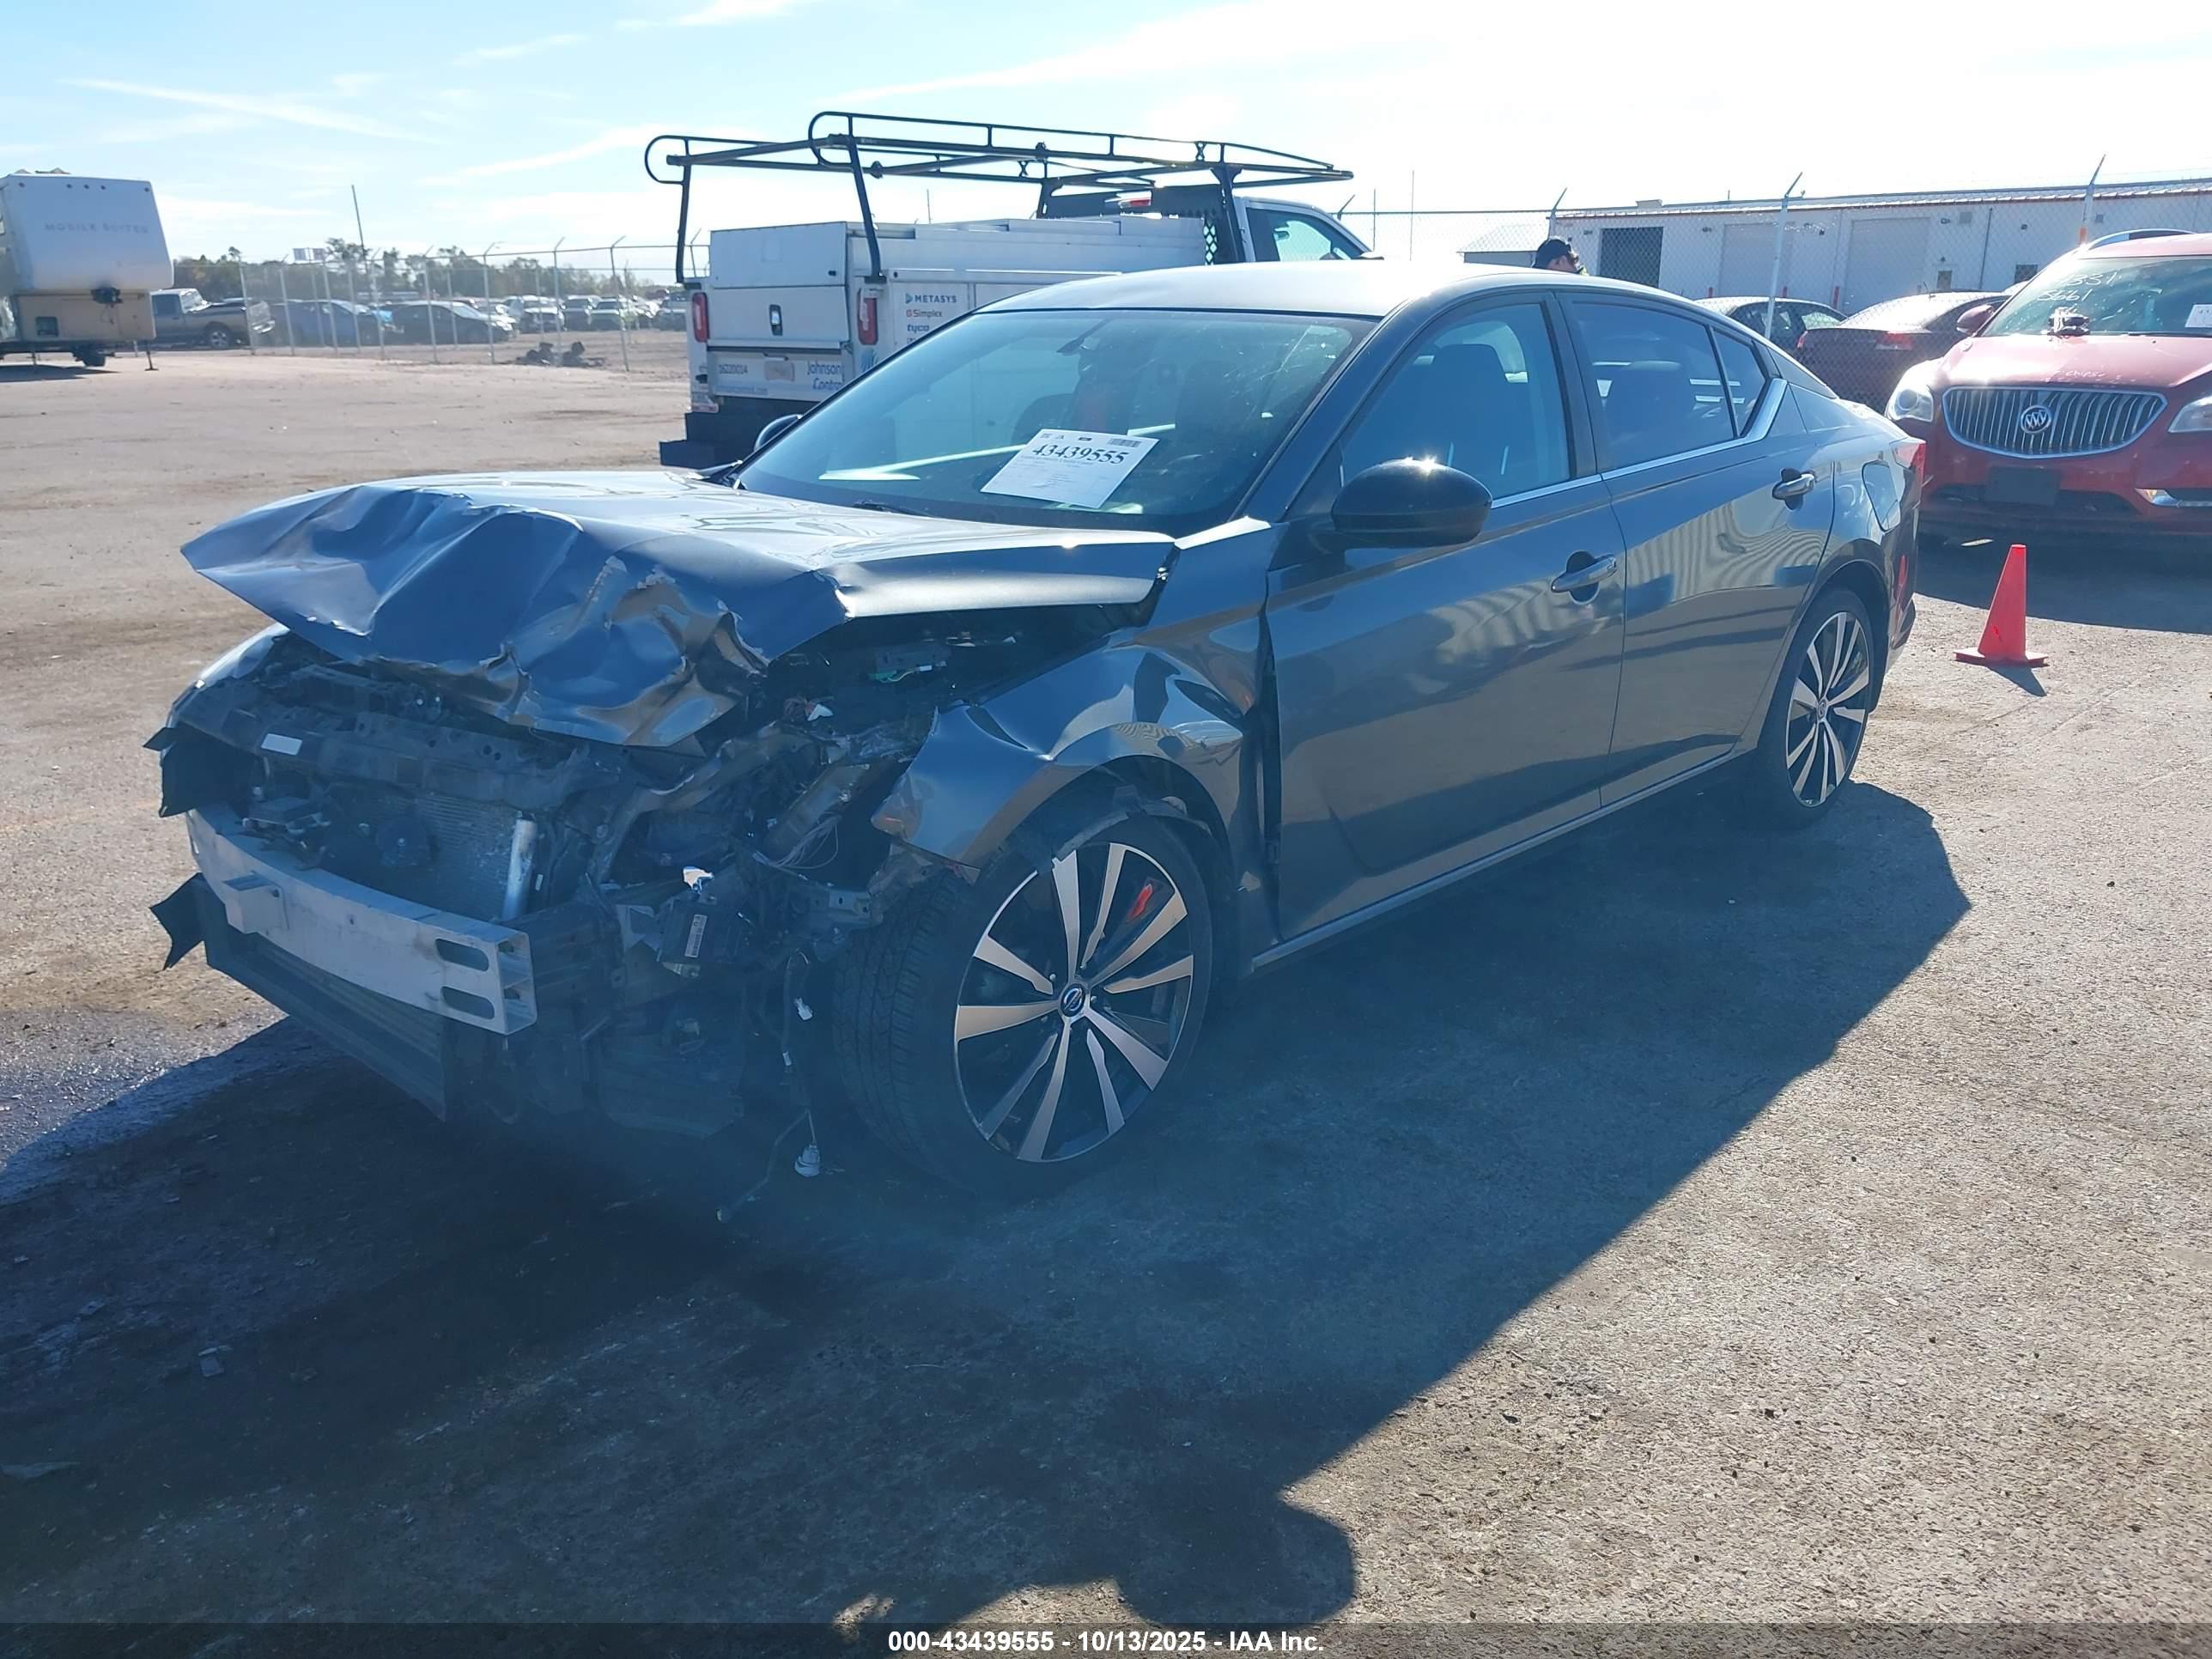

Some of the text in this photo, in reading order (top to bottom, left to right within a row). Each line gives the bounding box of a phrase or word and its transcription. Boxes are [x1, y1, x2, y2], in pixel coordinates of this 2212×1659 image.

[914, 295, 957, 303] METASYS
[806, 361, 842, 375] Johnson
[1032, 443, 1130, 465] 43439555
